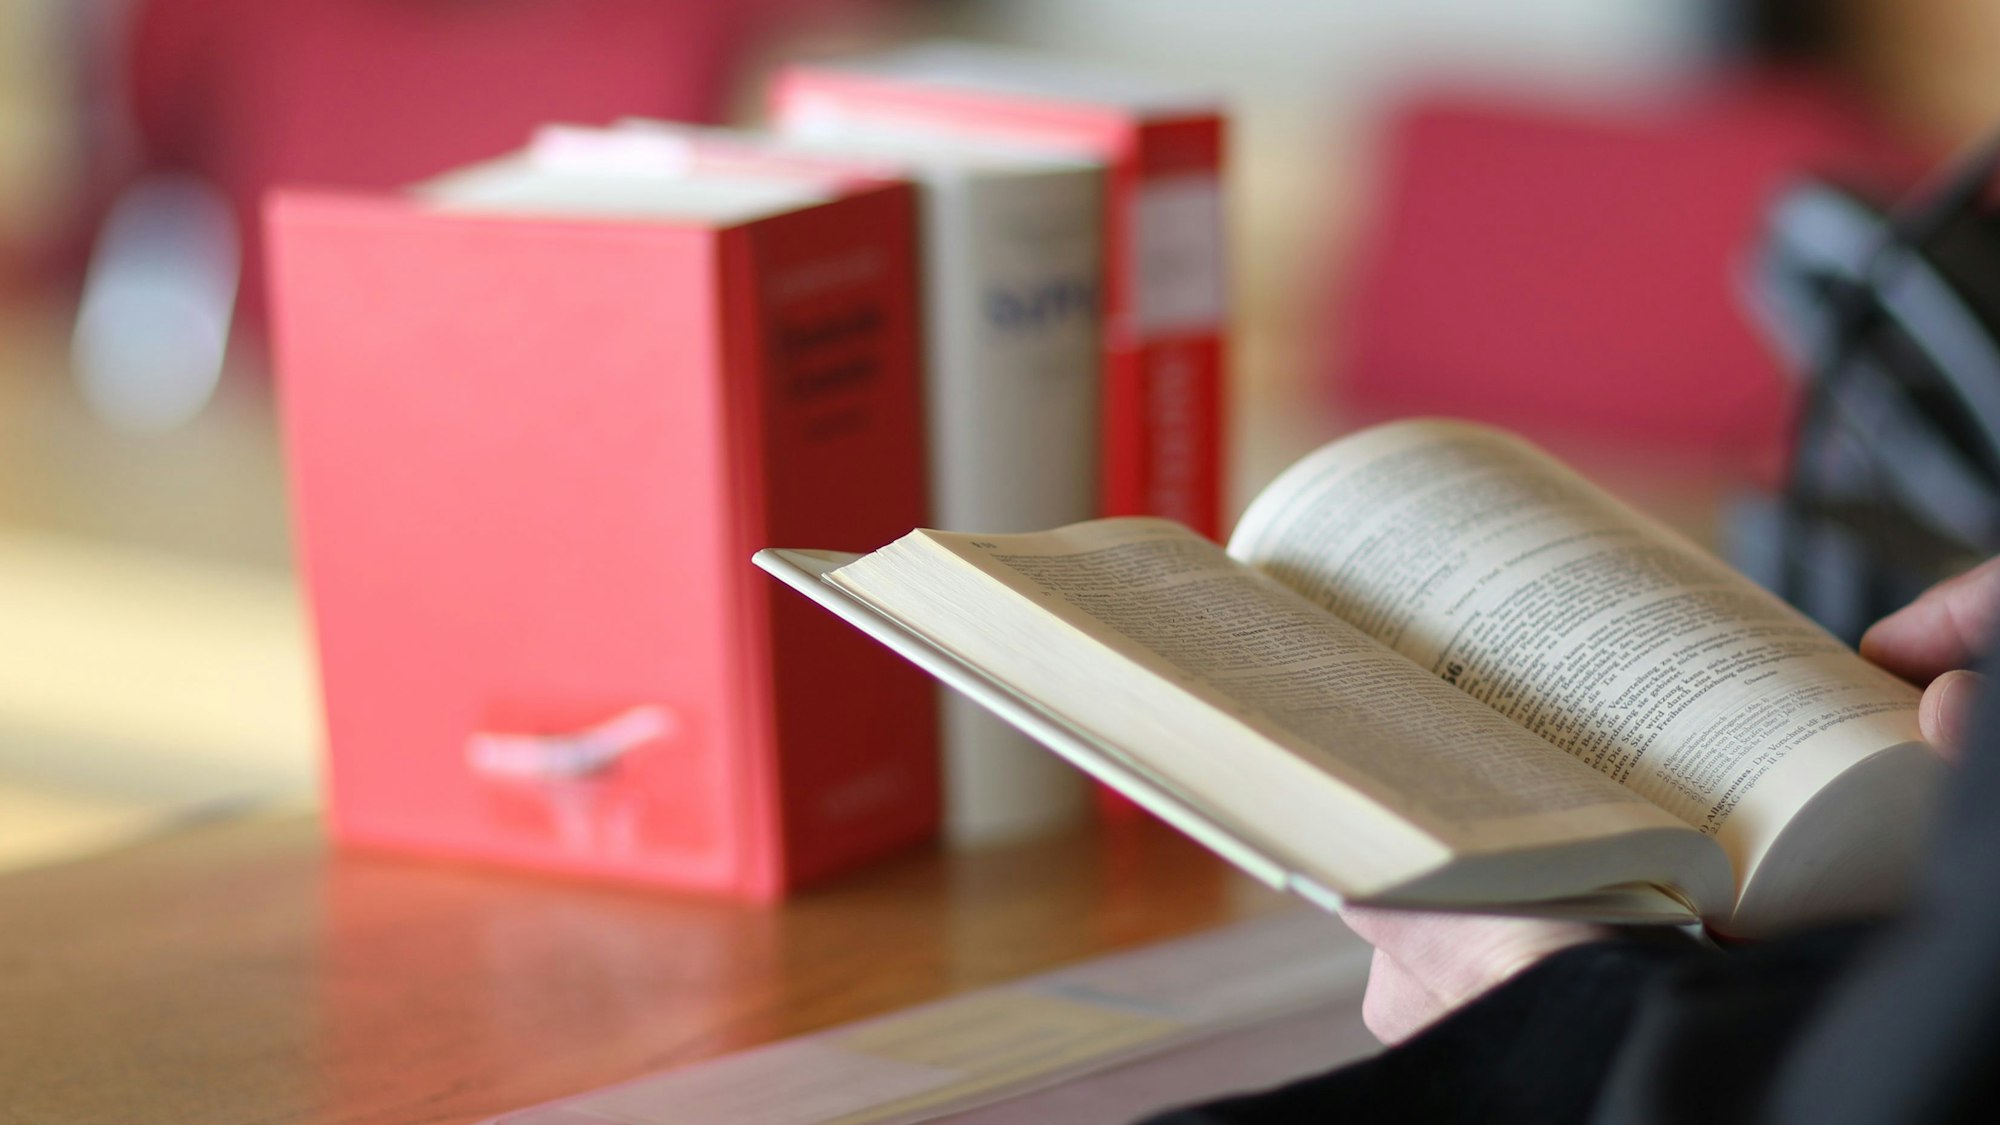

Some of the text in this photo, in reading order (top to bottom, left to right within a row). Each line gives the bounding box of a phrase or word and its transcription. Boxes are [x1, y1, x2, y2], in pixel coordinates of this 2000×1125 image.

[1536, 661, 1565, 692] Gericht
[1566, 706, 1587, 734] durch
[1588, 690, 1601, 704] die
[1602, 673, 1618, 686] Tat
[1567, 661, 1621, 714] Entscheidung
[1581, 730, 1596, 747] Bei
[1595, 712, 1610, 729] der
[1608, 665, 1661, 709] Verurteilung
[1637, 698, 1650, 708] sie
[1650, 670, 1686, 698] gebietet.
[1590, 730, 1607, 752] wird
[1607, 714, 1621, 729] die
[1620, 665, 1678, 710] Vollstreckung
[1607, 746, 1622, 765] Die
[1621, 684, 1684, 744] Strafaussetzung
[1681, 670, 1705, 685] kann
[1629, 732, 1659, 769] anderen
[1656, 671, 1738, 731] Freiheitsentziehung
[1630, 733, 1645, 748] Sie
[1646, 710, 1665, 730] wird
[1667, 689, 1692, 709] durch
[1694, 676, 1712, 689] eine
[1793, 729, 1819, 746] wurde
[1663, 732, 1698, 770] Allgemeines
[1715, 735, 1728, 747] von
[1706, 768, 1755, 823] Allgemeines.
[1752, 752, 1769, 766] Die
[1767, 726, 1807, 752] Vorschrift
